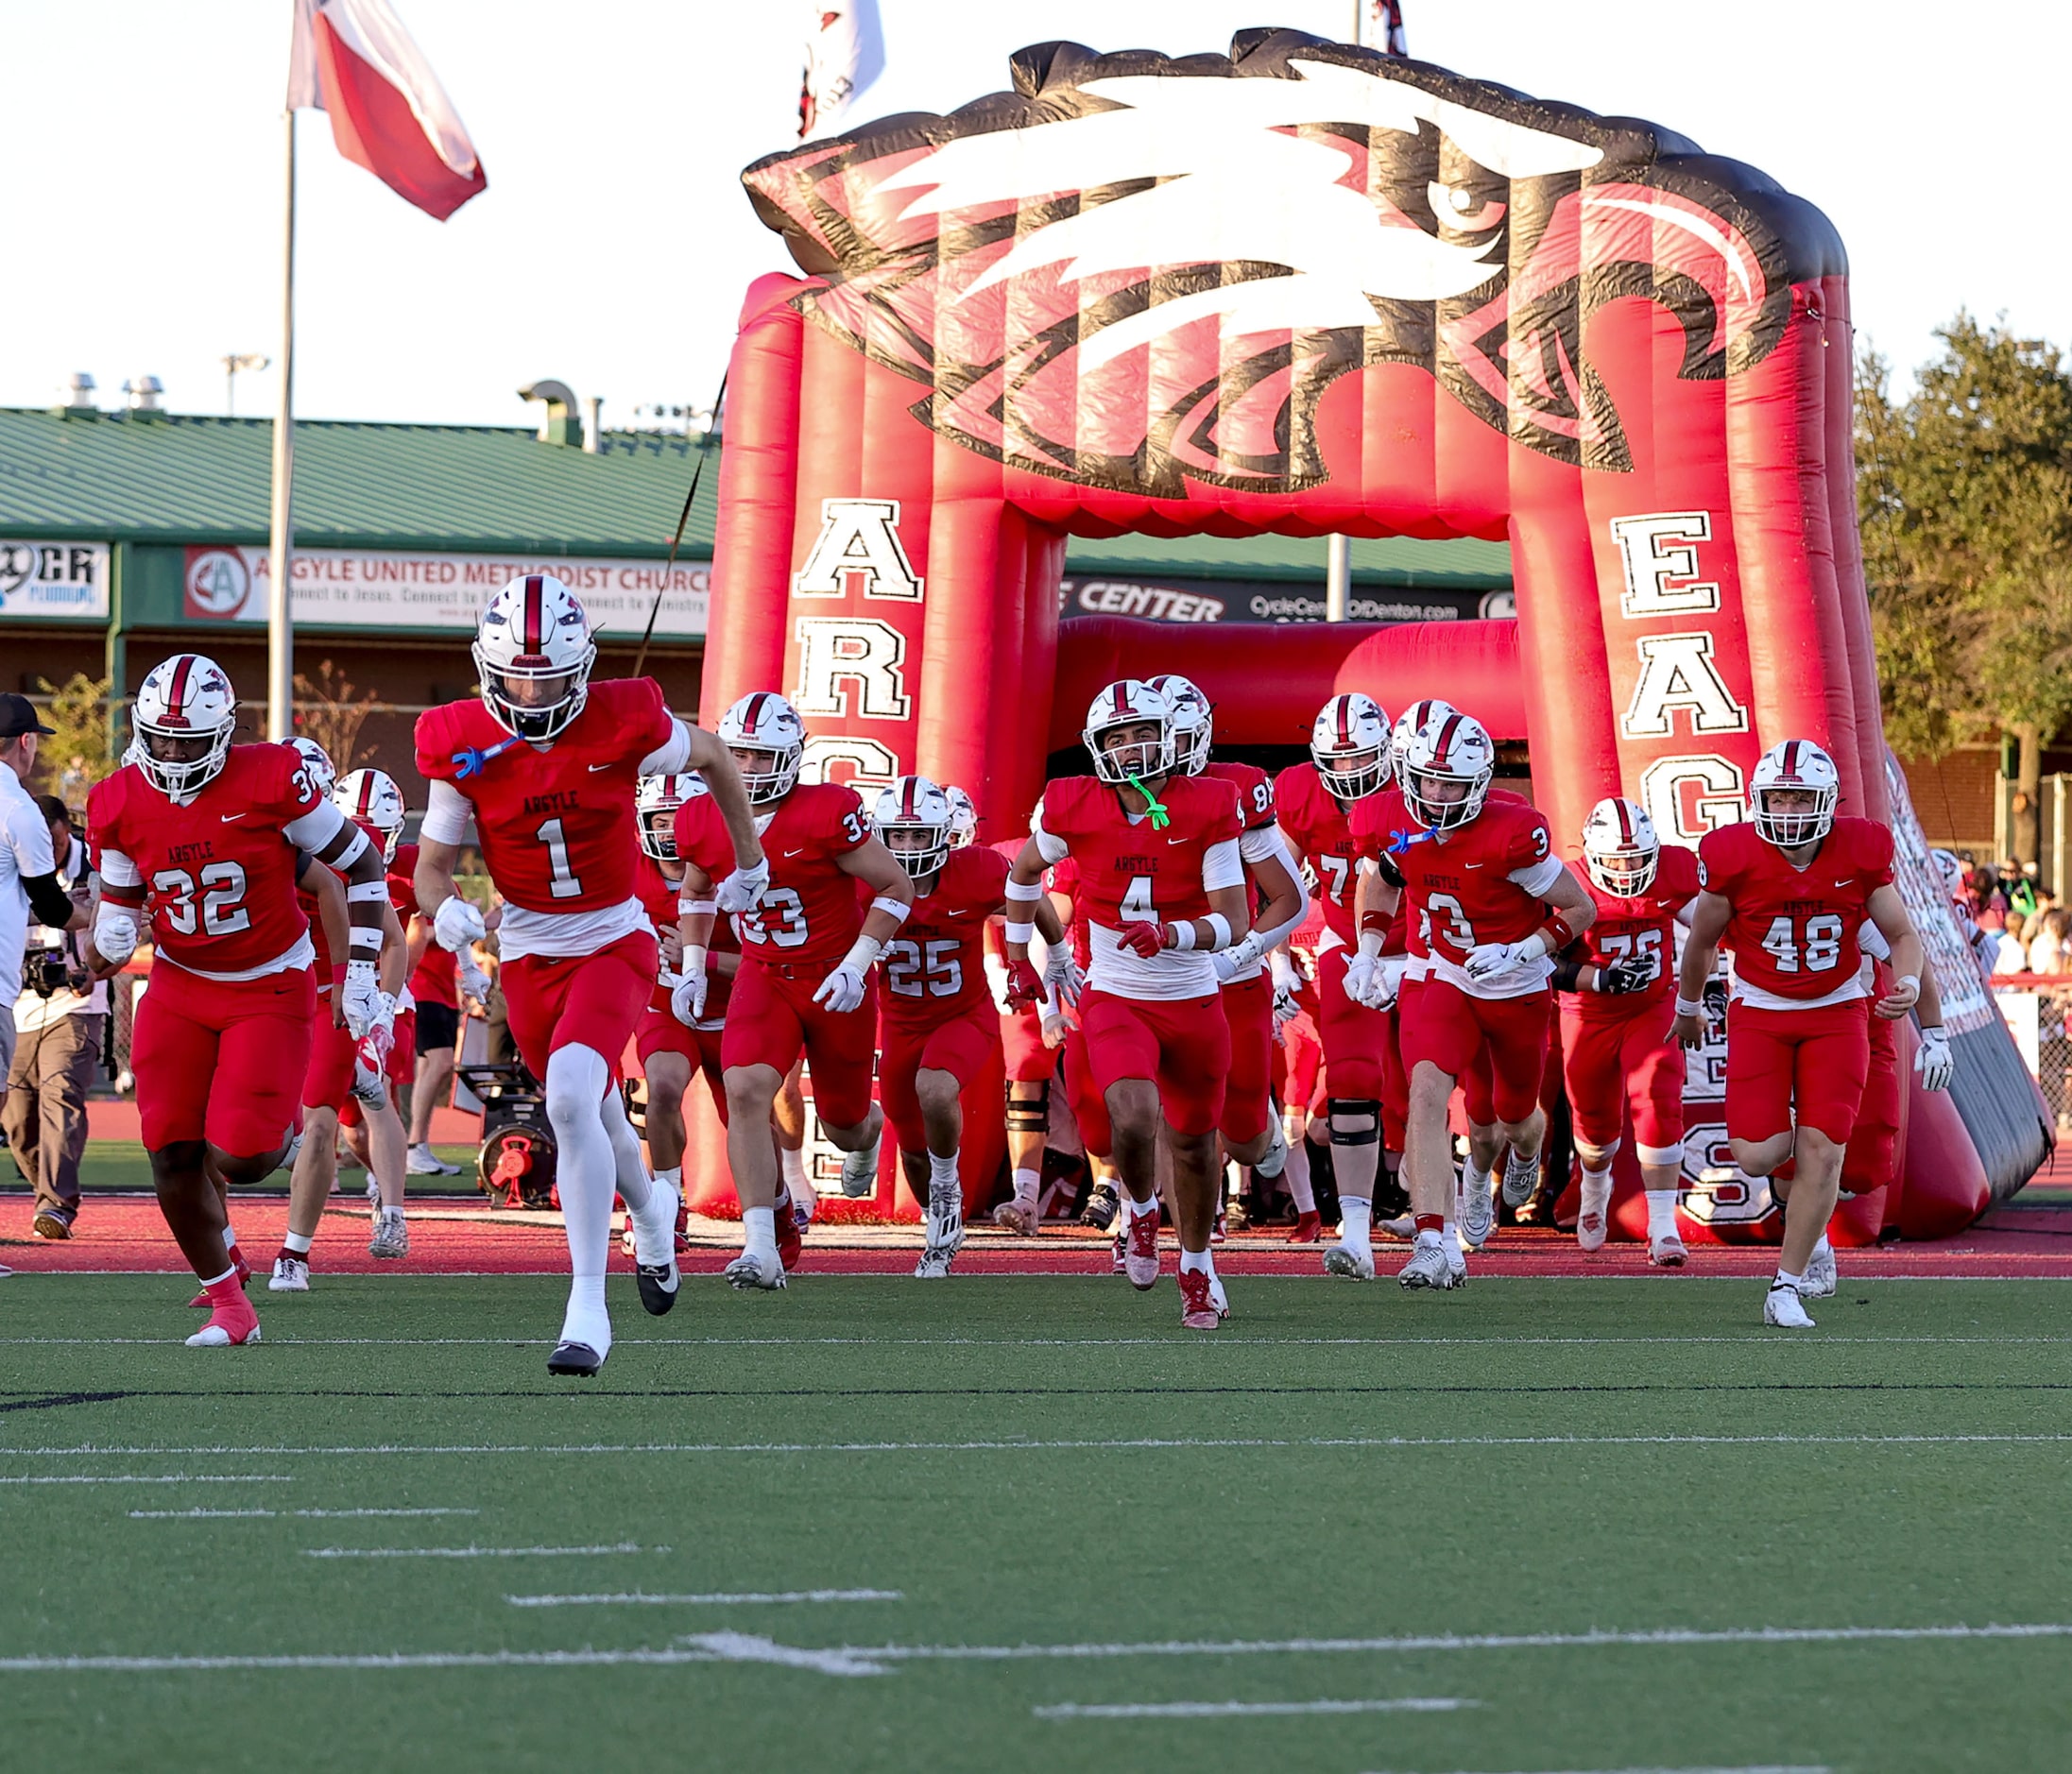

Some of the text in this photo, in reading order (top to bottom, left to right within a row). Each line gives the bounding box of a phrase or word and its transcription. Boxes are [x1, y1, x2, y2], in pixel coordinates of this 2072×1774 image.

[254, 555, 356, 582] AGYLE
[362, 558, 456, 584] UNITED
[619, 568, 711, 592] CHURC
[1078, 581, 1224, 623] CENTER
[523, 790, 580, 816] ARGYLE
[167, 840, 214, 864] ARGYLE
[535, 816, 584, 898] 1
[1531, 826, 1549, 857] 3
[1114, 856, 1159, 873] ARGYLE
[1423, 873, 1462, 891] ARGYLE
[151, 859, 252, 936] 32
[1118, 874, 1161, 925] 4
[1428, 891, 1477, 949] 3
[1760, 913, 1844, 973] 48
[888, 939, 964, 998] 25
